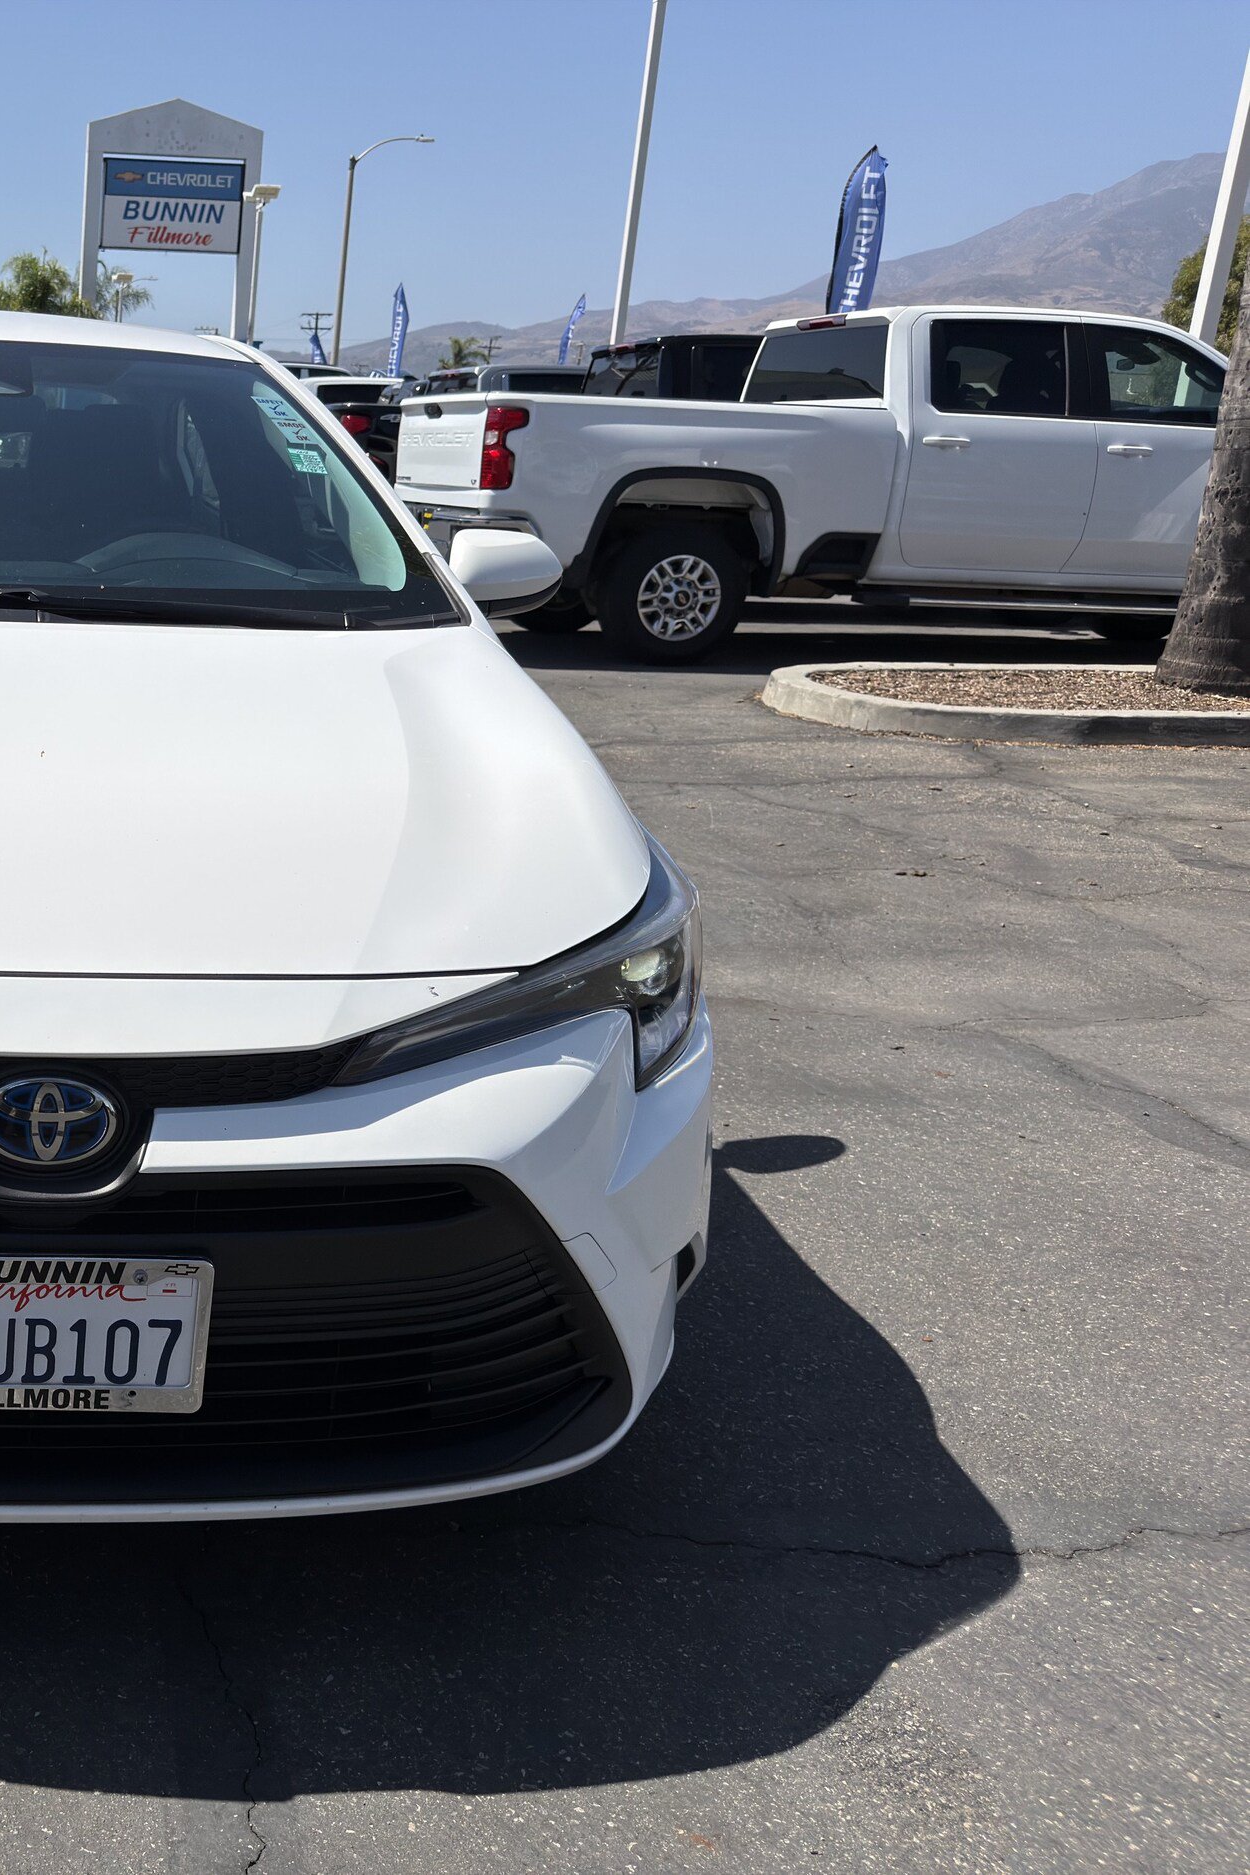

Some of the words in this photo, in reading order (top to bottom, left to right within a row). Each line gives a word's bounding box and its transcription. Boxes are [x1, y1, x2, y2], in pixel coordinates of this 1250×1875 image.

[147, 172, 234, 188] CHEVROLET
[122, 200, 225, 224] BUNNIN
[127, 226, 213, 246] Fillmore
[255, 398, 284, 406] SAFETY
